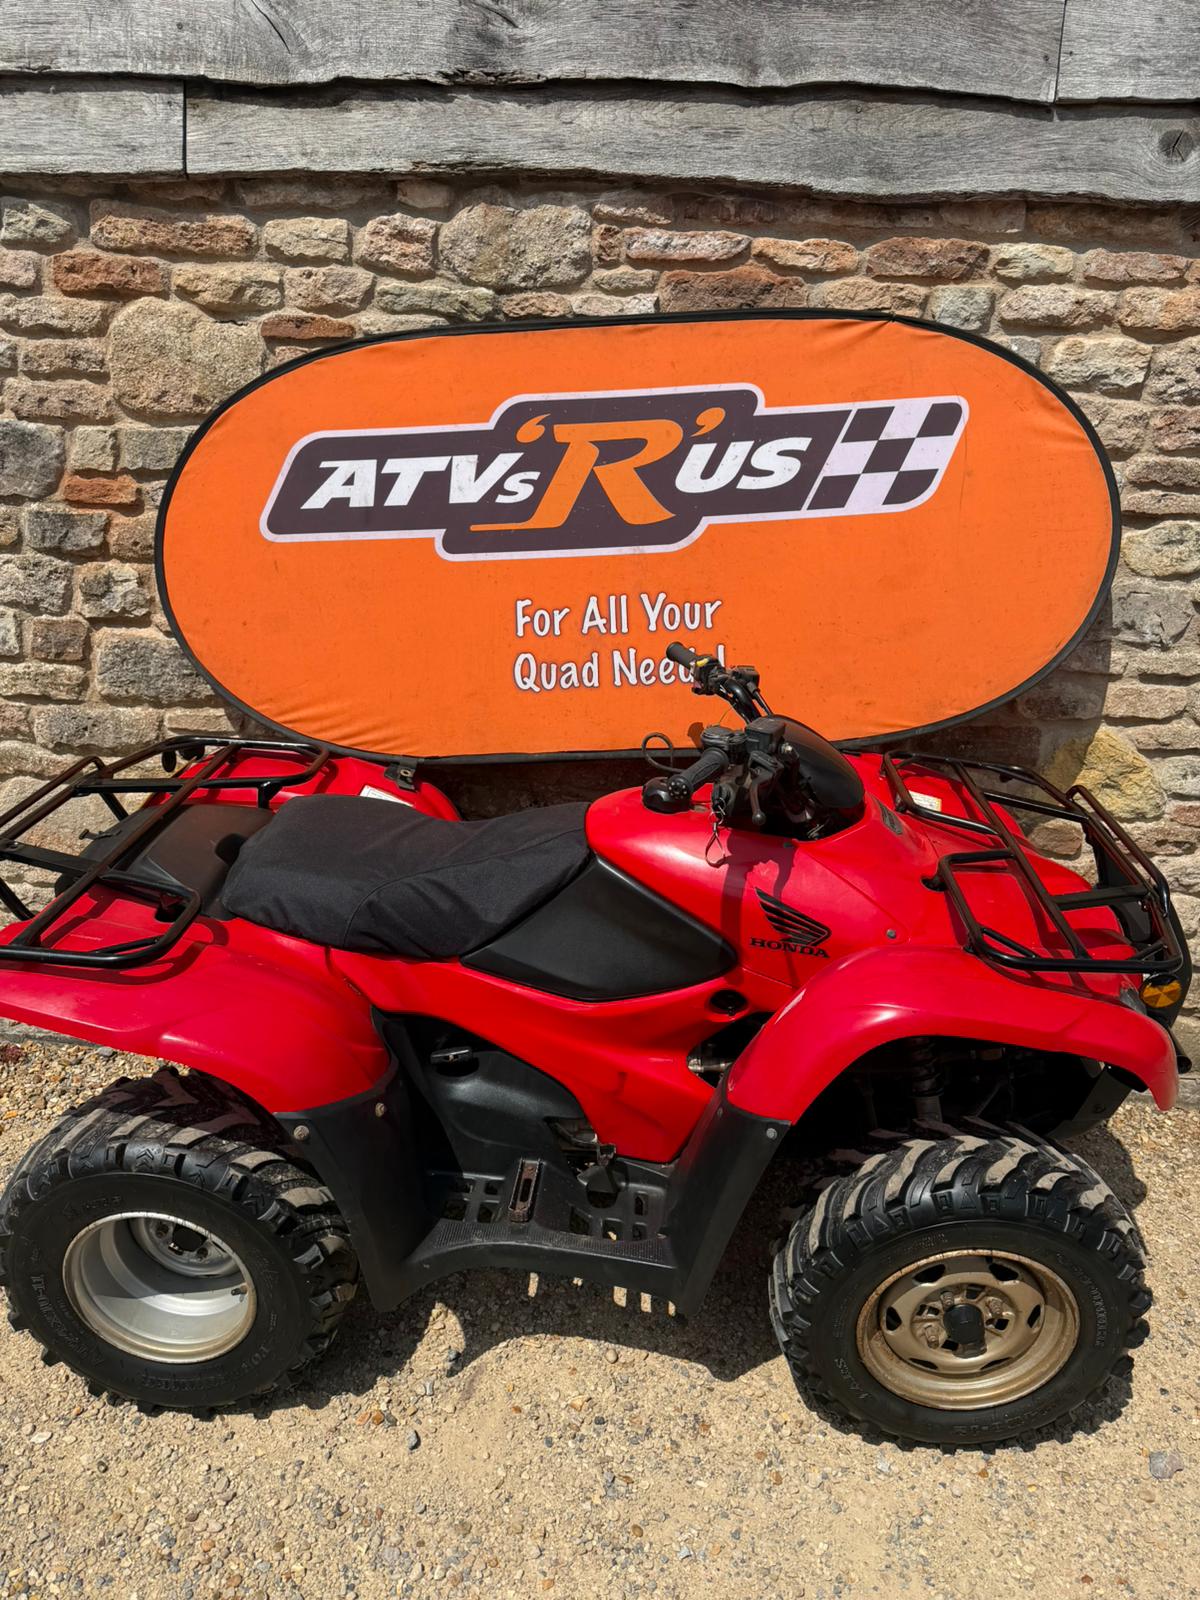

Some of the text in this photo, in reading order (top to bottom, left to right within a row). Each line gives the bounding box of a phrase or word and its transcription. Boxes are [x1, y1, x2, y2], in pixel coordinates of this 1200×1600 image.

[299, 452, 542, 510] ATVs
[515, 591, 723, 638] For All Your
[513, 651, 600, 692] Quad
[749, 936, 831, 959] HONDA
